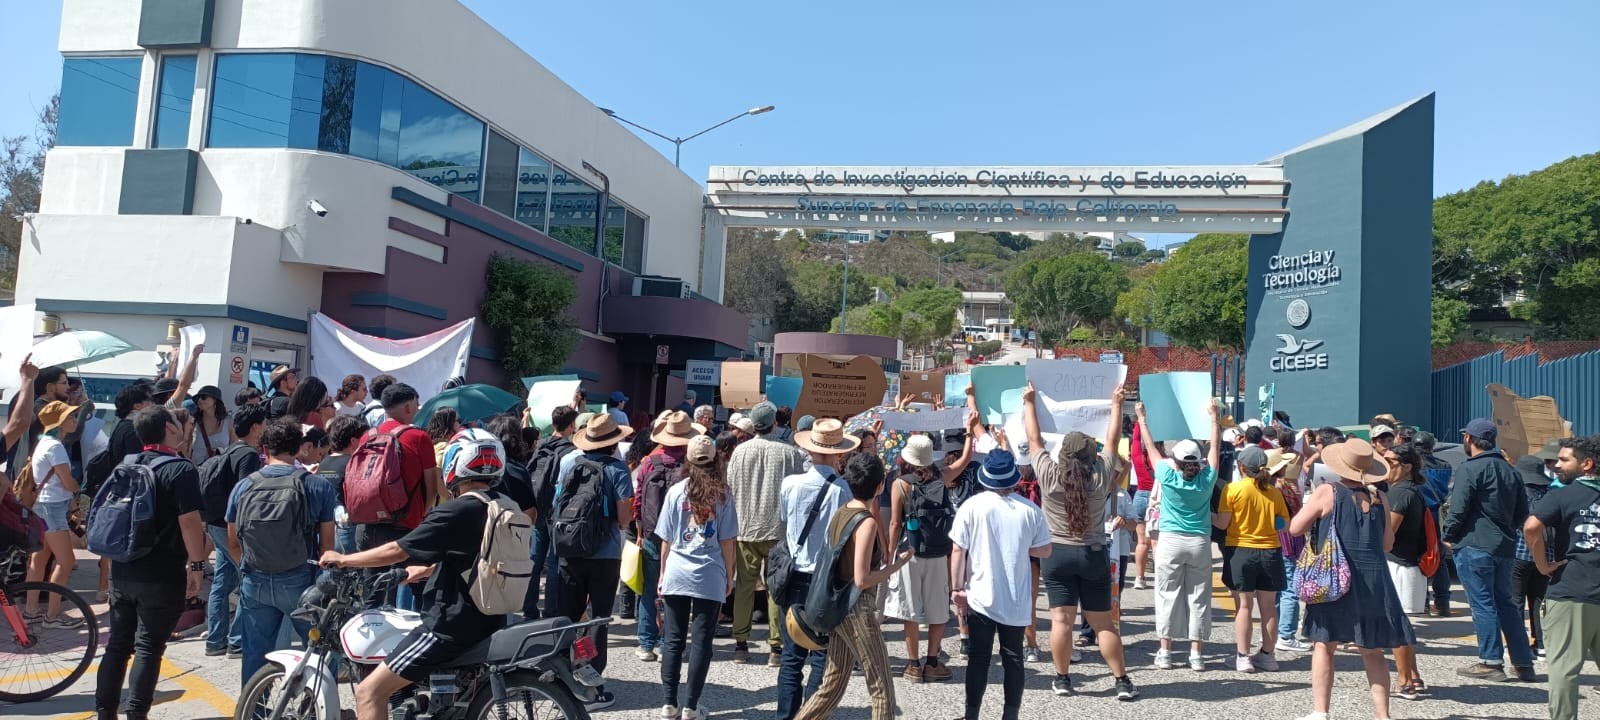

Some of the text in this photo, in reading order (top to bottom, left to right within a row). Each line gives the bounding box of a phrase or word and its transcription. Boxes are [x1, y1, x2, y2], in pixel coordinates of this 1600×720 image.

[742, 170, 1248, 192] Centro de Investigación Científica y de Educación
[797, 196, 1178, 218] Superior de Ensenada Baja California
[1269, 249, 1334, 270] Ciencia y
[1262, 263, 1340, 288] Tecnología
[1270, 353, 1327, 370] CICESE
